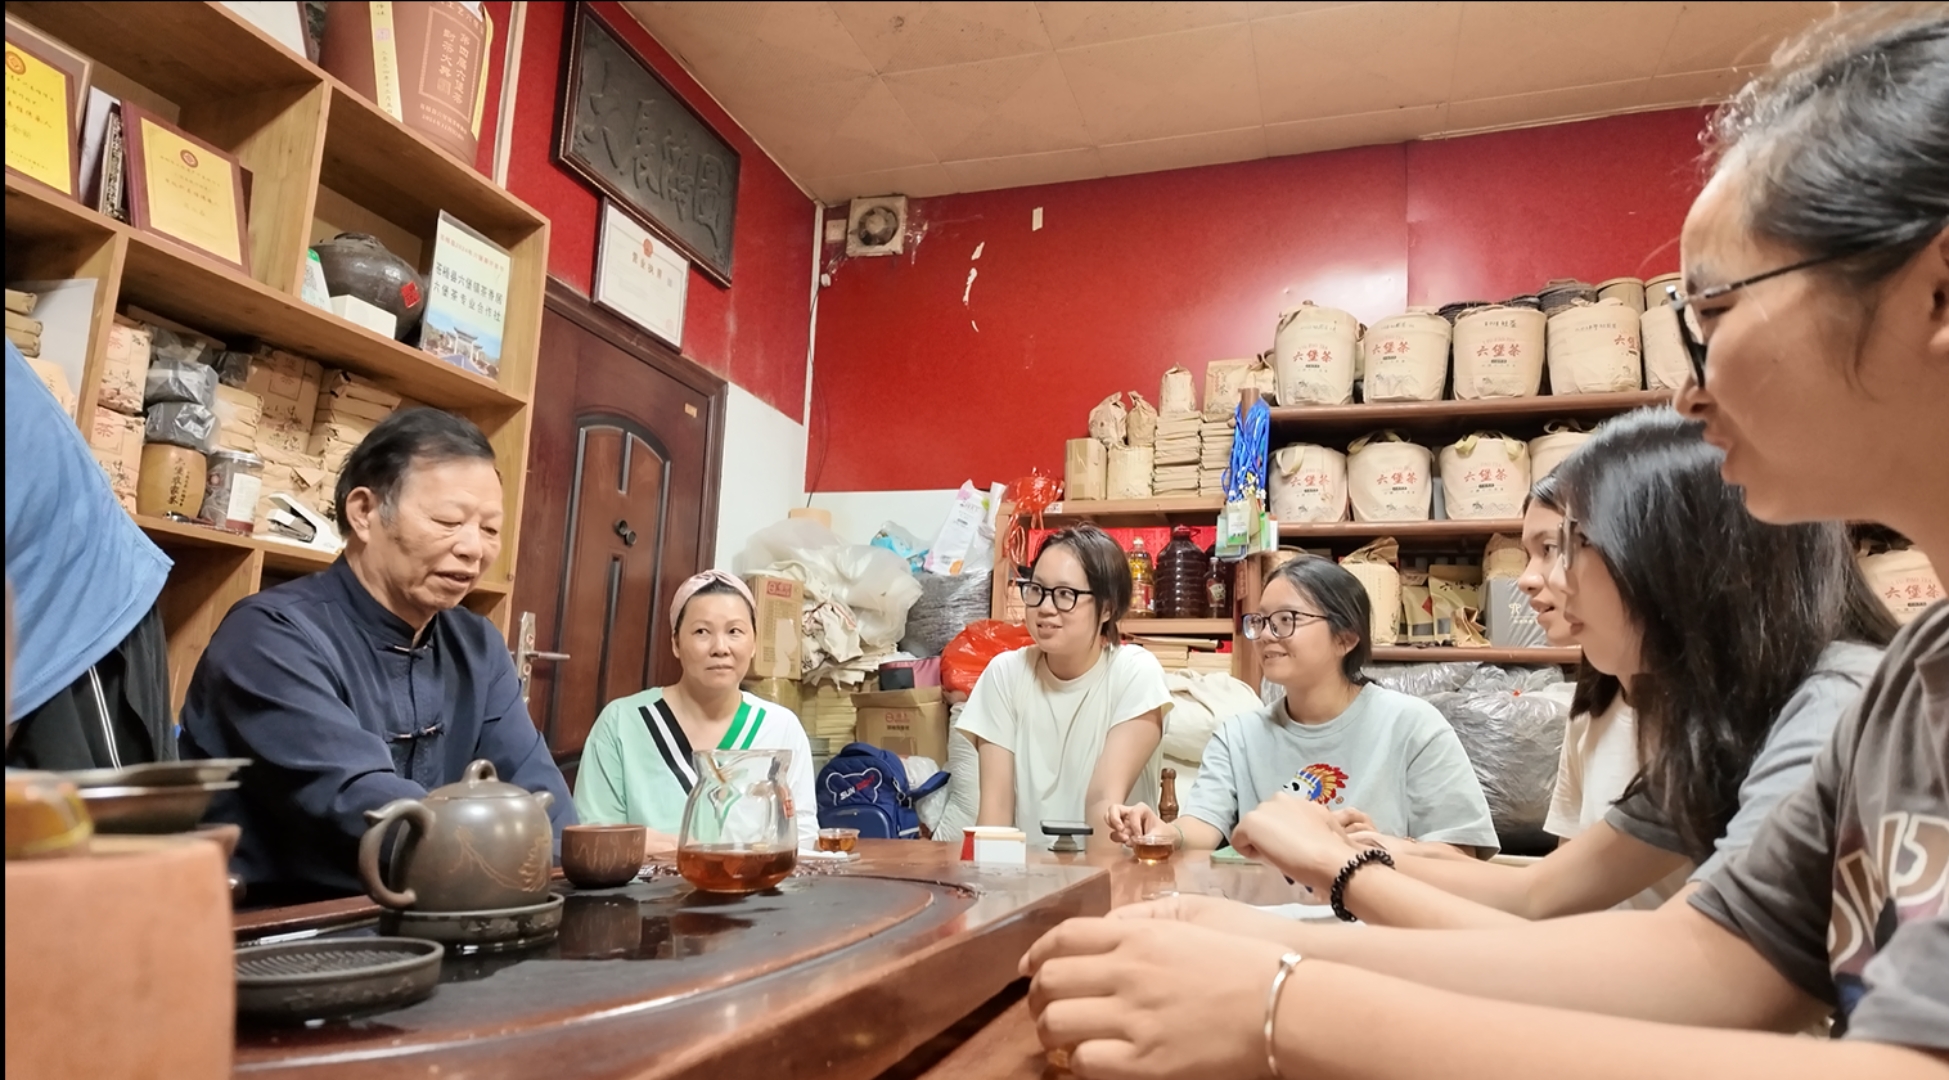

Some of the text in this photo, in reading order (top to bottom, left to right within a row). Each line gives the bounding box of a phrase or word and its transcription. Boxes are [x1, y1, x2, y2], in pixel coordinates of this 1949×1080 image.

[632, 251, 662, 280] 营业执照
[433, 280, 501, 322] 六堡茶专业合作社
[1372, 341, 1411, 355] 六堡茶
[1614, 333, 1641, 350] 六堡
[1293, 349, 1333, 363] 六堡茶
[1477, 343, 1521, 358] 六堡茶
[1290, 474, 1331, 488] 六堡茶
[1376, 471, 1418, 486] 六堡茶
[1463, 467, 1508, 483] 六堡茶
[1885, 583, 1940, 600] 六堡茶
[841, 786, 856, 800] SUN
